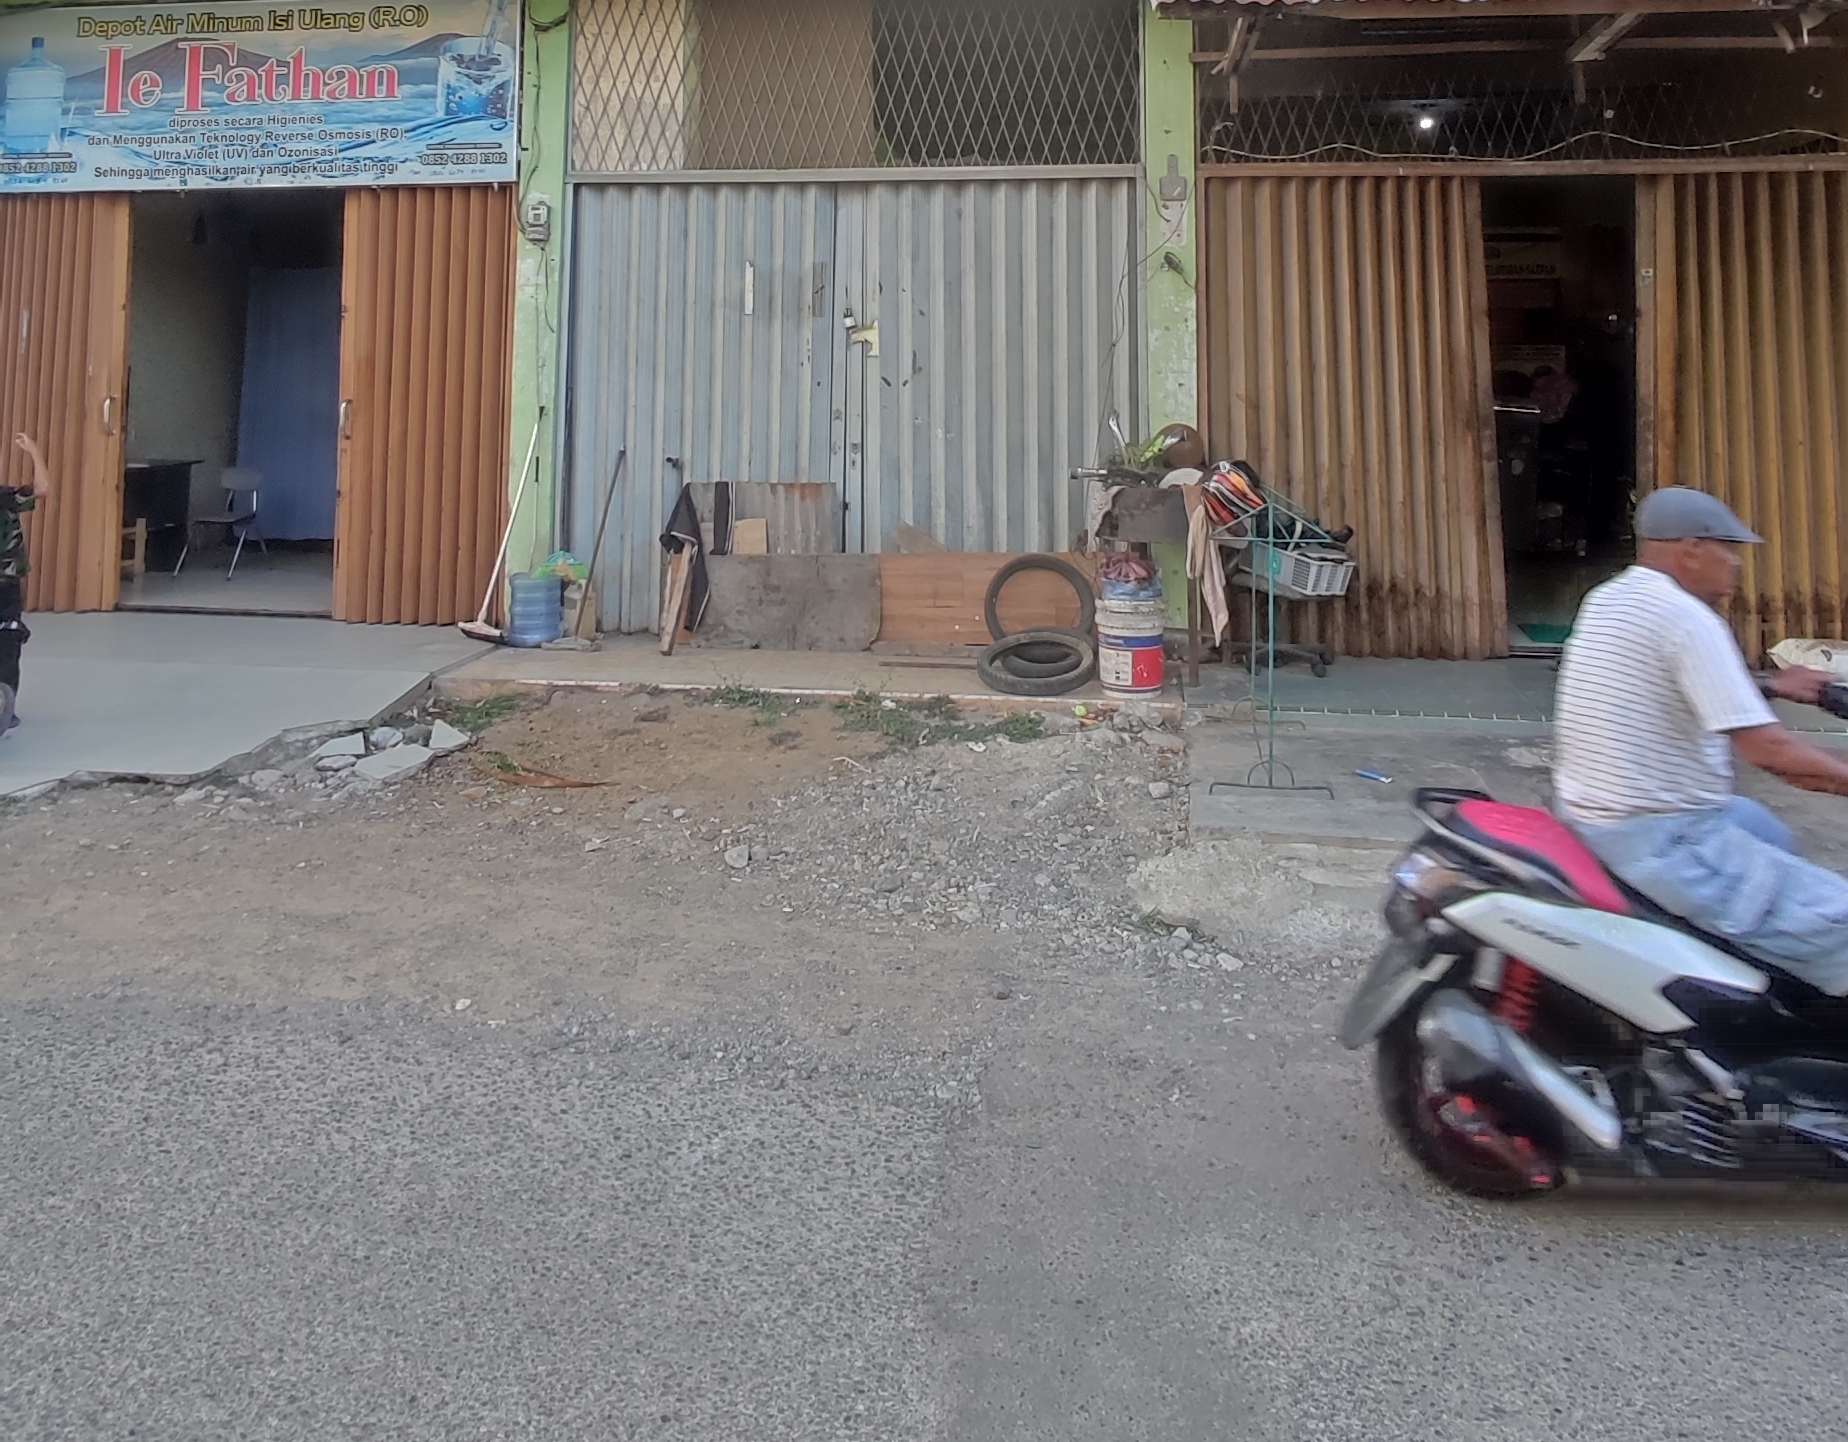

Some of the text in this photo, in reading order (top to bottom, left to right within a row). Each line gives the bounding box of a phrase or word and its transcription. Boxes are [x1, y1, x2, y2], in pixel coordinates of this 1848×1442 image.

[77, 4, 429, 39] Depot Air Minum Isi Ulang (R.O)
[175, 39, 401, 115] Fathan
[168, 114, 324, 129] diproses secara Higienies
[87, 135, 110, 146] dan
[113, 133, 197, 147] Menggunakan
[199, 131, 262, 146] Teknology
[265, 130, 315, 142] Reverse
[317, 128, 373, 141] Osmosis
[153, 146, 339, 161] Ultra Violet (UV) dan Ozonisasi
[421, 152, 508, 166] 0852 4288 1302
[0, 163, 22, 174] 852
[23, 162, 50, 174] 4288
[94, 166, 151, 179] Sehingga
[153, 164, 236, 179] menghasilkan
[240, 164, 256, 175] air
[259, 164, 290, 177] yang
[292, 162, 362, 174] berkualitas
[363, 161, 400, 174] tinggi
